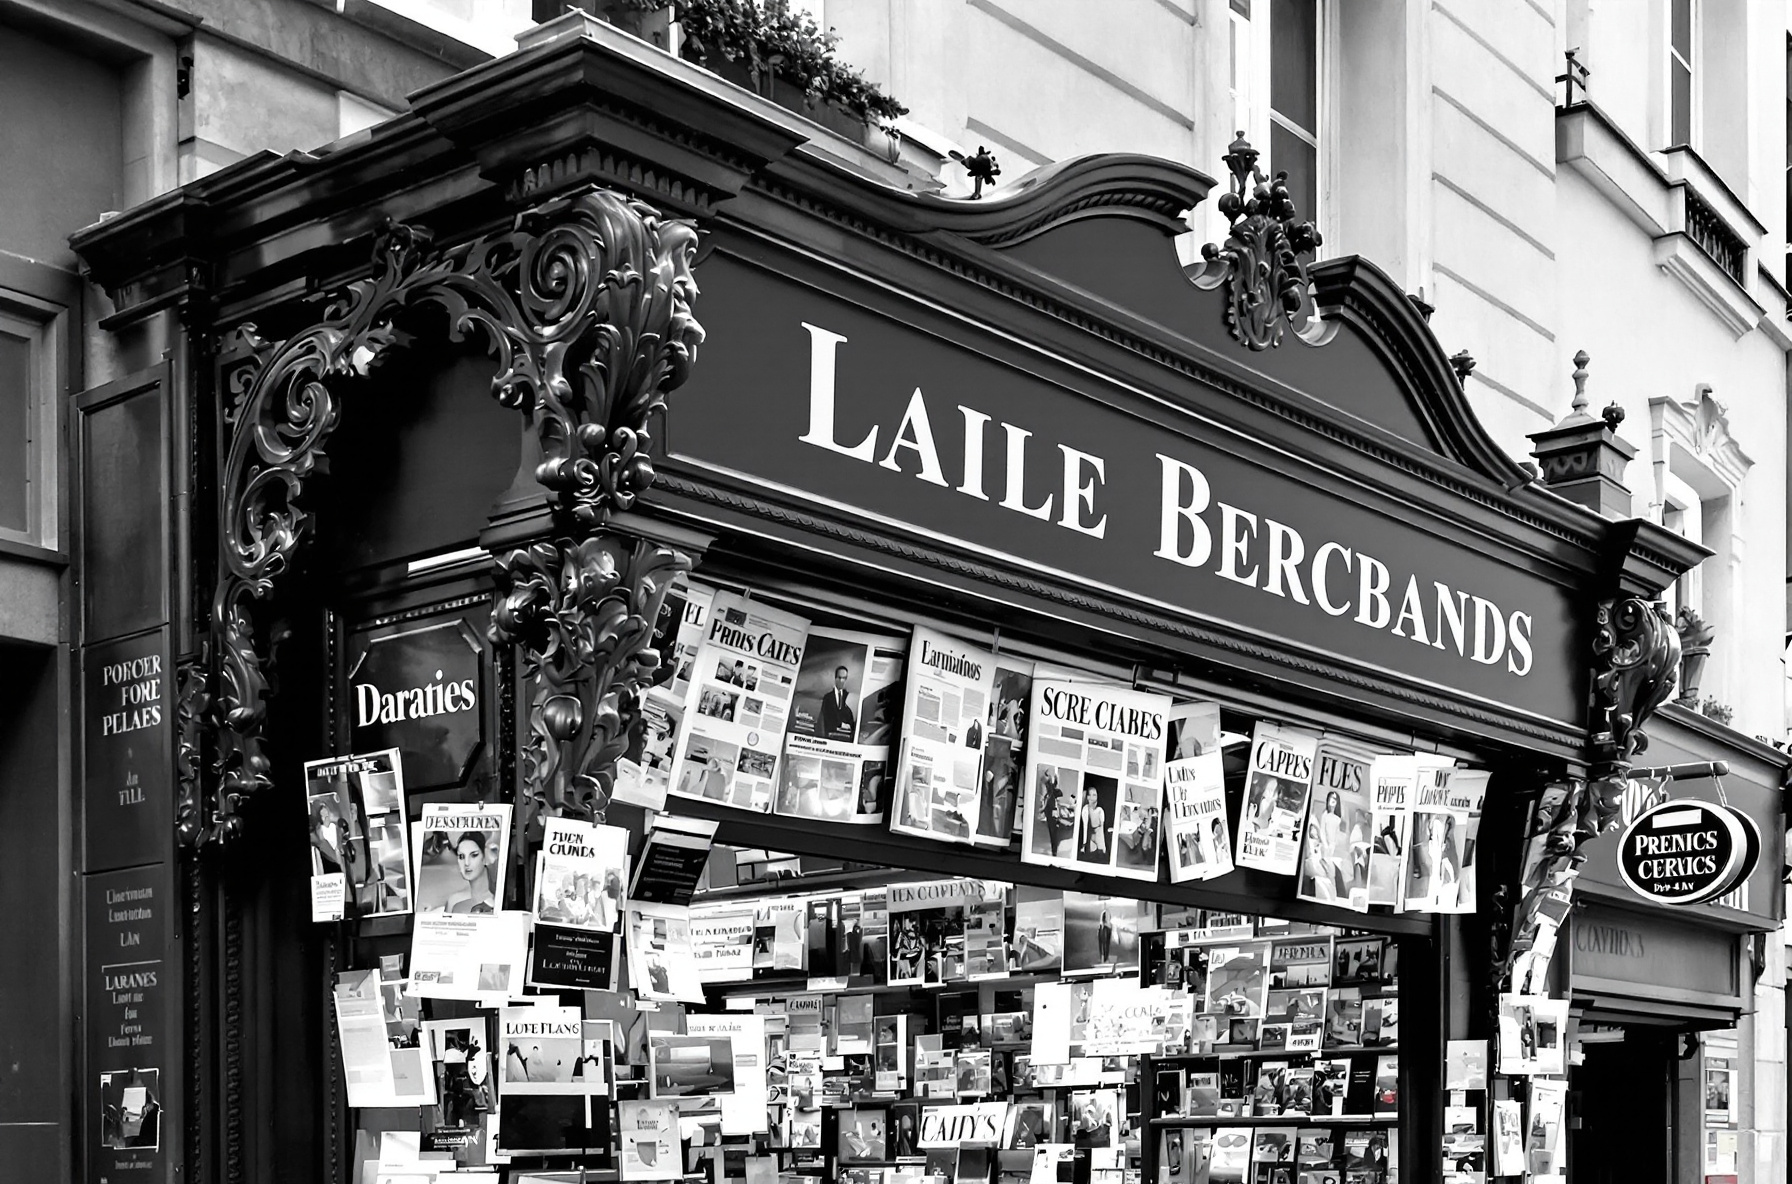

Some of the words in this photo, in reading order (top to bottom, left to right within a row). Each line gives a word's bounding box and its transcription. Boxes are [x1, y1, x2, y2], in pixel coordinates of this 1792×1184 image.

[799, 321, 1108, 540] LAILE
[1152, 453, 1534, 676] BERCBANDS
[355, 669, 476, 727] Daraties
[1041, 686, 1092, 726] SCRE
